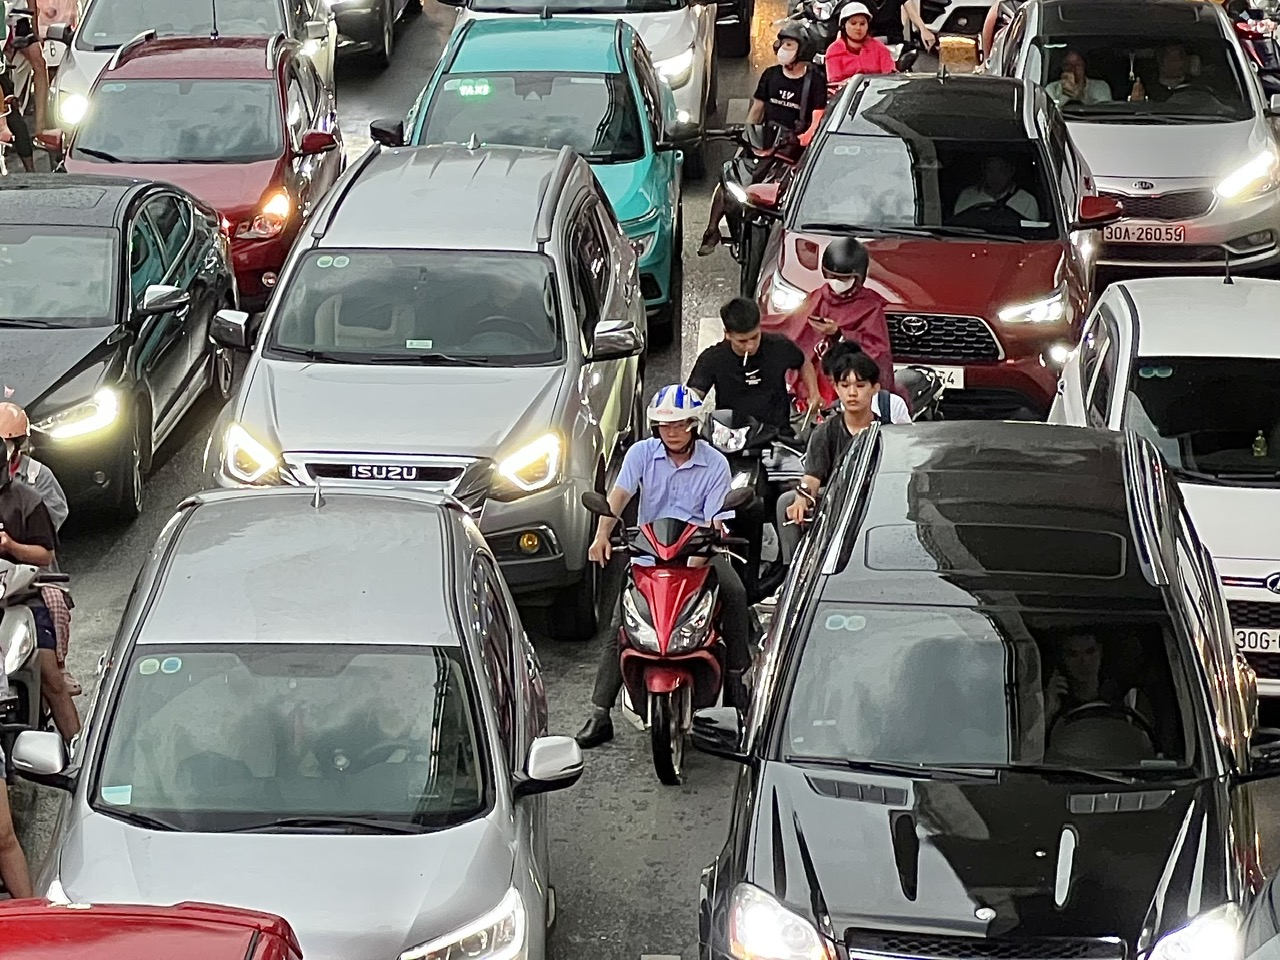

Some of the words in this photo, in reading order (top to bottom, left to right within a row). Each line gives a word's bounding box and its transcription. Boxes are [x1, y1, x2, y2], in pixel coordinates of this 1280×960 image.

[1105, 226, 1184, 242] 30A-260.59
[351, 465, 417, 480] ISUZU
[1235, 630, 1280, 650] 30G-
